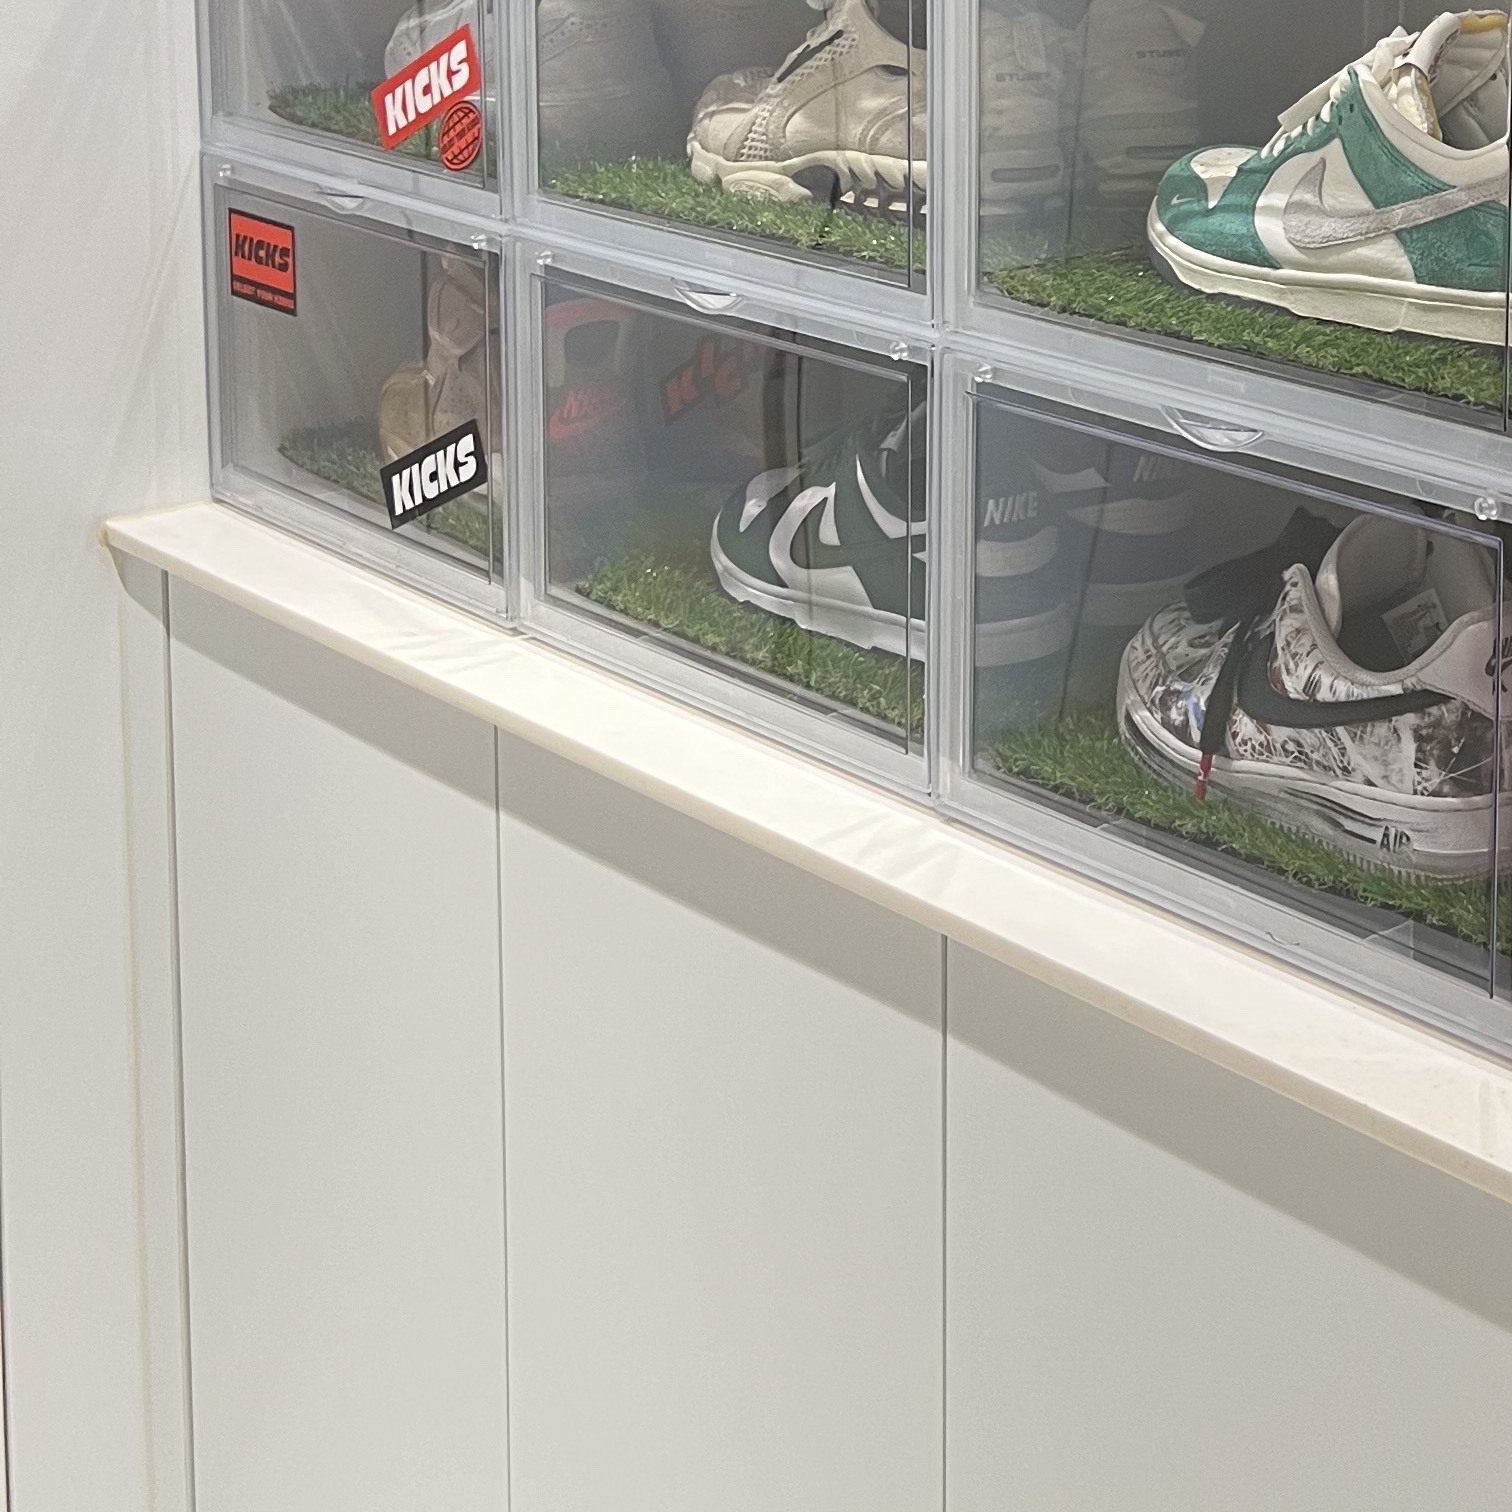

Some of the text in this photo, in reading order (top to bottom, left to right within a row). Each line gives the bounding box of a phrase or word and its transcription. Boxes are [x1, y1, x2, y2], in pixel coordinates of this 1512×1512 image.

[384, 39, 470, 136] KICKS
[234, 233, 291, 273] KICKS
[390, 431, 479, 517] KICKS
[984, 491, 1039, 528] NIKE
